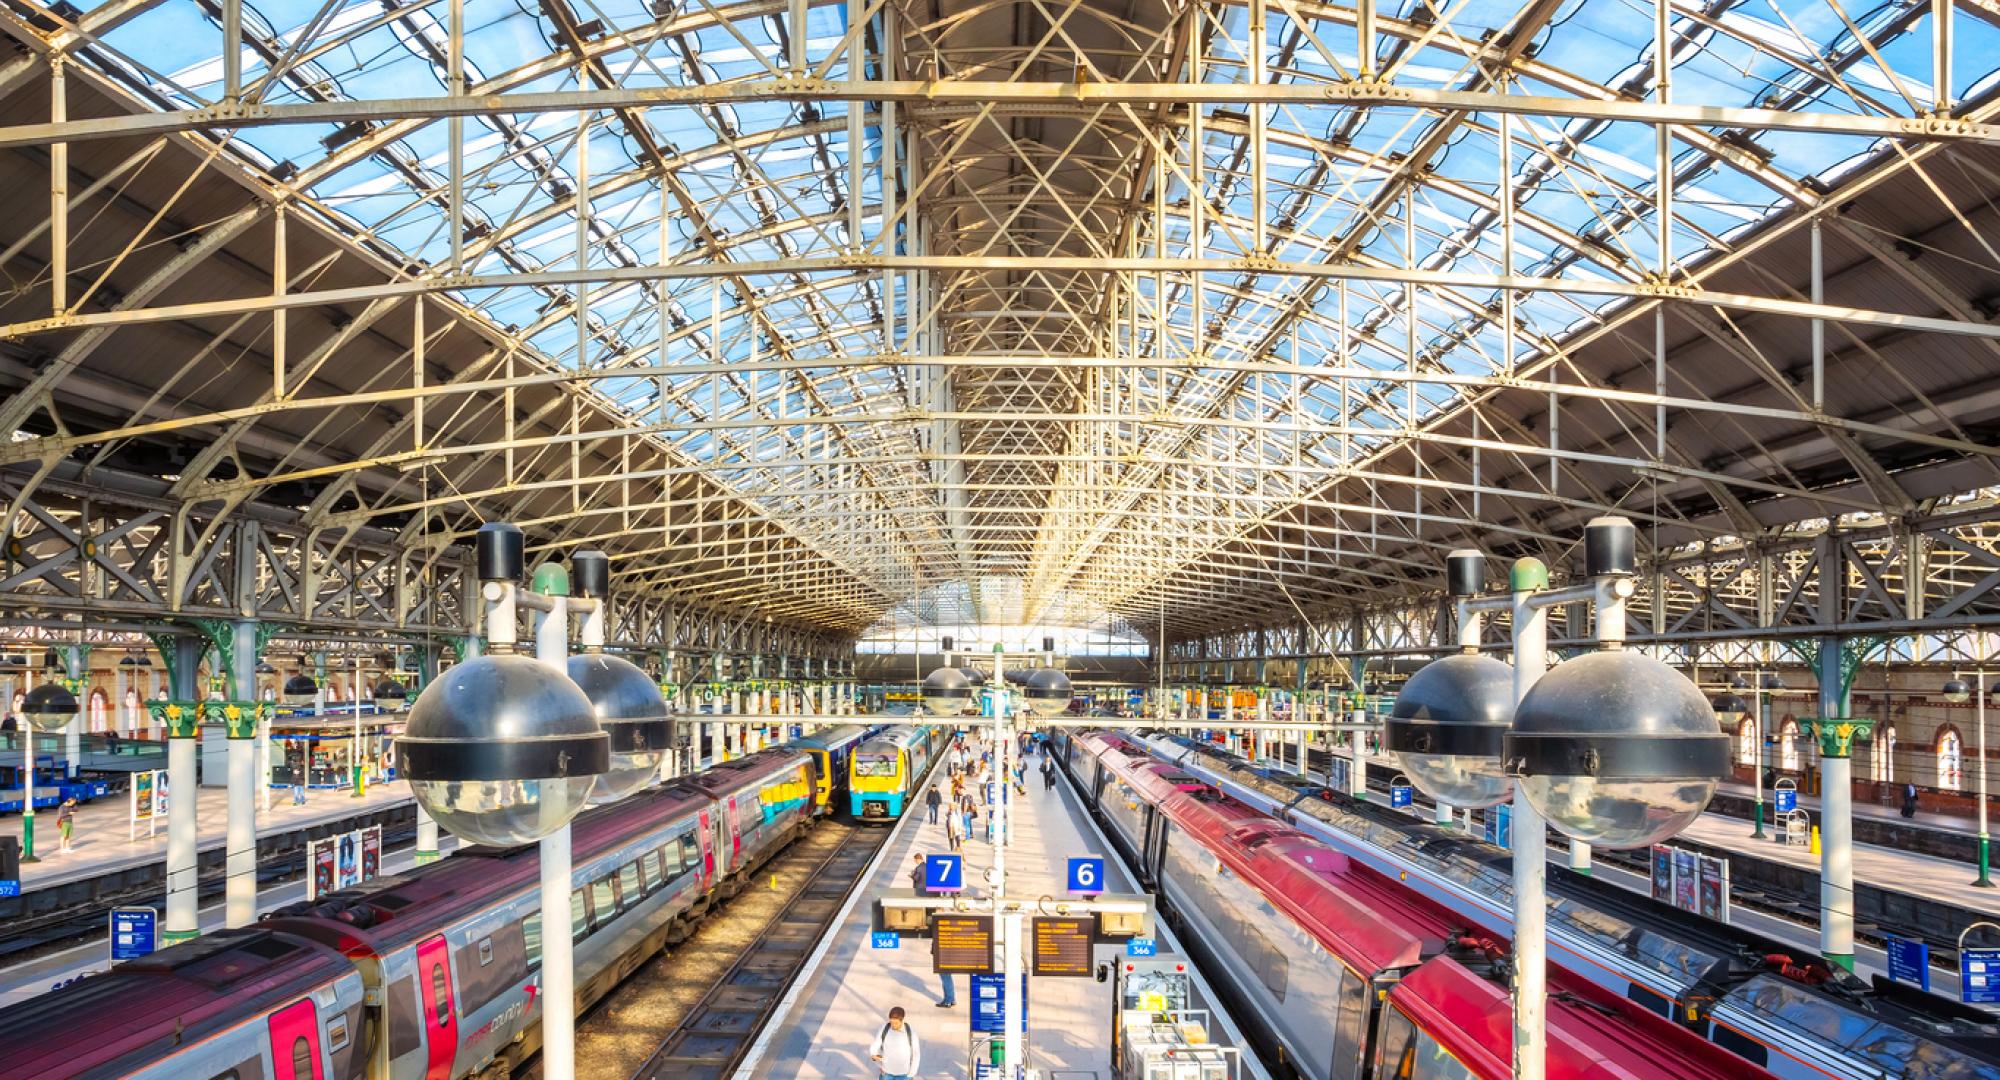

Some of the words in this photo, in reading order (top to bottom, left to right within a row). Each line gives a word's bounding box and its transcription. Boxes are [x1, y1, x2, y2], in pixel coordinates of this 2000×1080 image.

[936, 860, 953, 882] 7
[1077, 863, 1094, 886] 6
[877, 939, 893, 948] 368
[1133, 946, 1150, 955] 366
